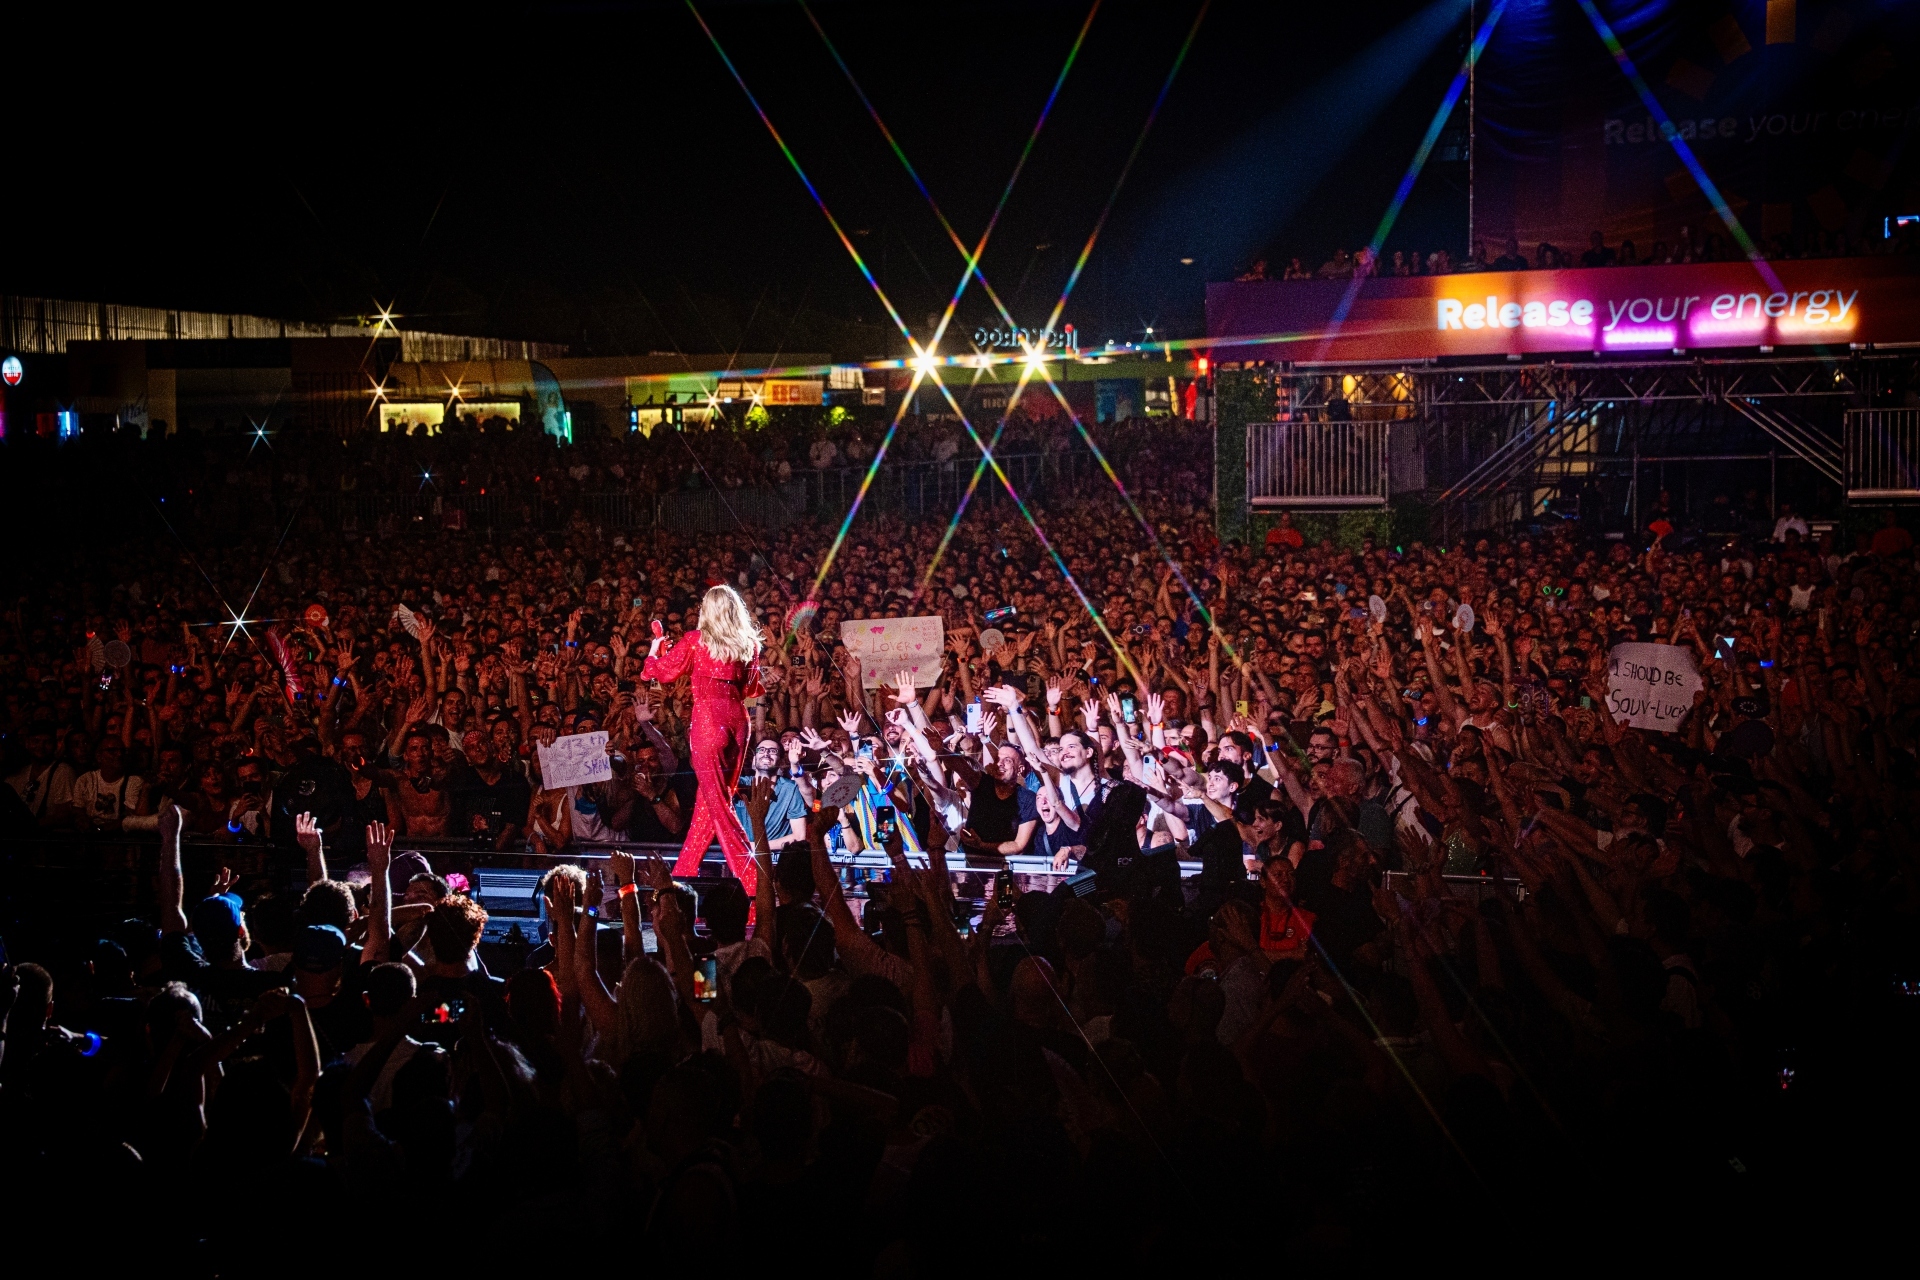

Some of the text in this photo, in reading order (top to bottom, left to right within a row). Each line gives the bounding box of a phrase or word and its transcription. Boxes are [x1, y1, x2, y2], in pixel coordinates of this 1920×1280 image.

[1743, 112, 1829, 144] your
[1836, 105, 1920, 131] ener
[1437, 288, 1859, 331] Release your energy
